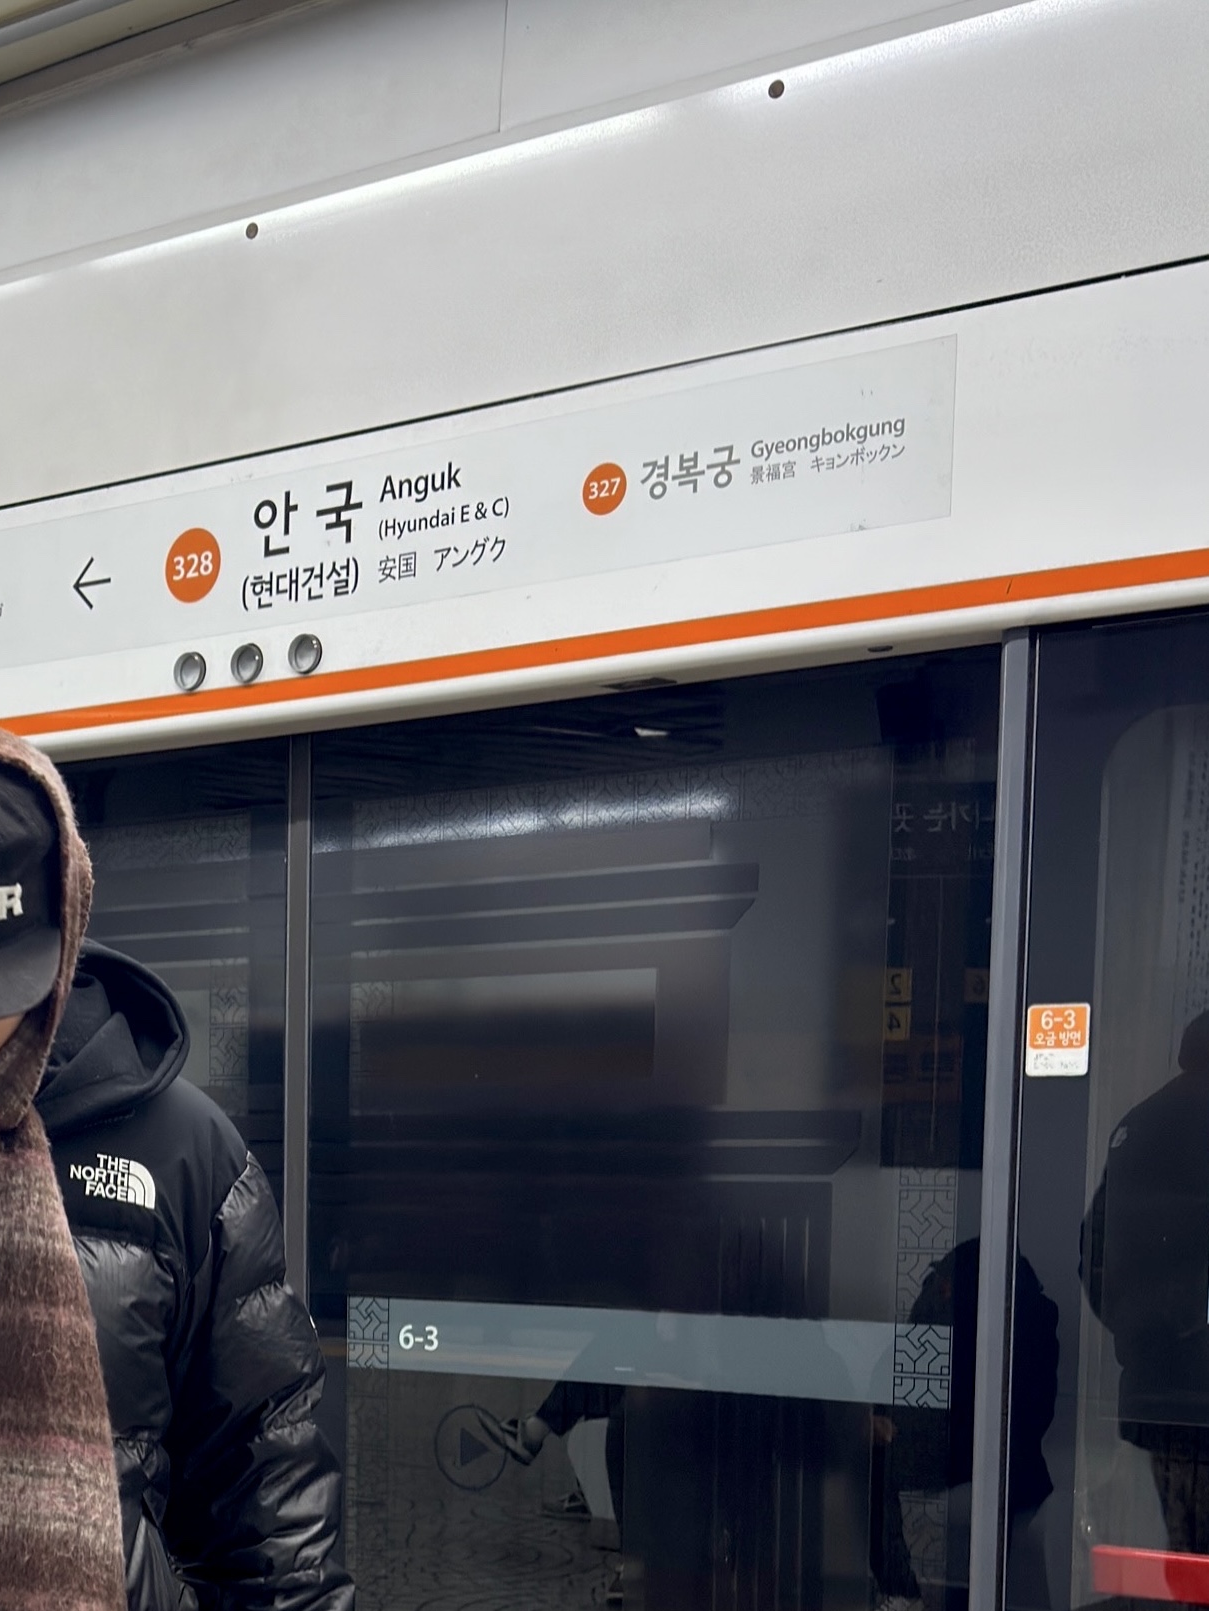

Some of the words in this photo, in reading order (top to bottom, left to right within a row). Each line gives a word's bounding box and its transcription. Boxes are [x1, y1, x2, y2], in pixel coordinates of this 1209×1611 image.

[750, 417, 906, 461] Gyeongbokgung
[640, 444, 741, 500] 경복궁
[810, 443, 906, 473] キョンボックン
[379, 462, 462, 503] Anguk
[588, 477, 621, 500] 327
[378, 506, 456, 541] (Hyundai
[460, 504, 471, 523] E
[474, 501, 488, 520] &
[492, 496, 510, 519] C)
[172, 550, 214, 582] 328
[378, 551, 417, 583] 安国
[434, 535, 506, 572] アングク
[241, 556, 360, 611] (현대건설)
[1041, 1009, 1076, 1031] 6-3
[1034, 1032, 1057, 1047] 오금
[1059, 1030, 1081, 1046] 방면
[69, 1164, 129, 1188] NORTH
[96, 1153, 130, 1174] THE
[85, 1180, 128, 1203] FACE
[398, 1324, 439, 1352] 6-3
